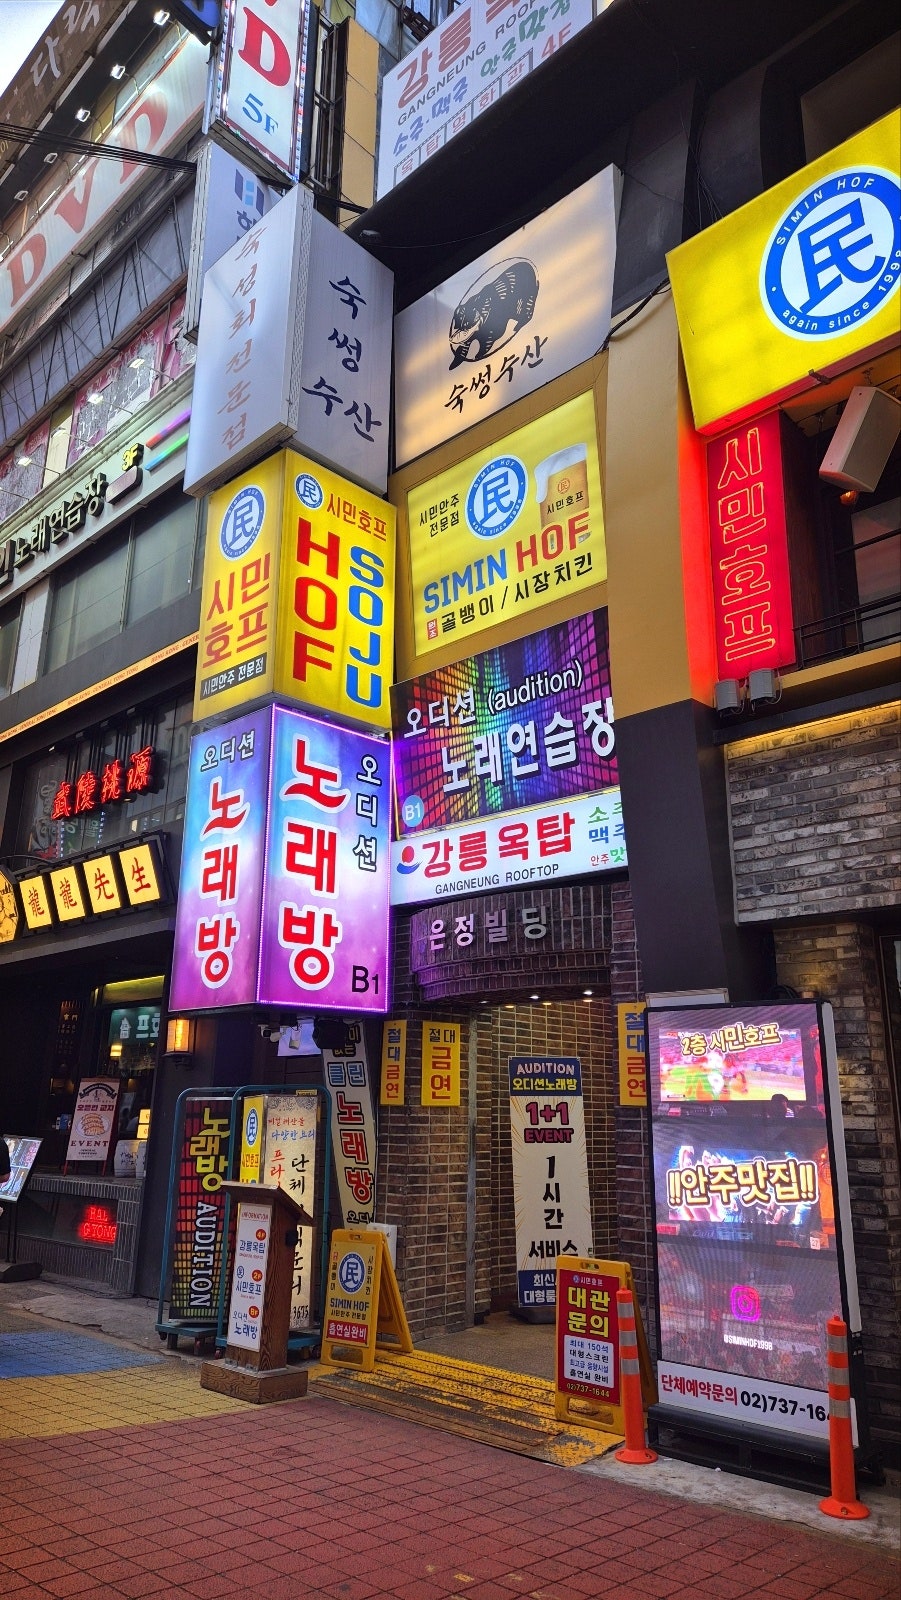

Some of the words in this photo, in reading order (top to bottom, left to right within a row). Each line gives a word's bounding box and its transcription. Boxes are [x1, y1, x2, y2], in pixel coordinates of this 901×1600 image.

[541, 22, 572, 58] 4F
[397, 40, 486, 127] GANGNEUNG
[5, 91, 168, 307] DVD
[776, 190, 823, 246] SIMIN
[836, 176, 875, 192] HOF
[797, 197, 886, 315] 民
[782, 308, 818, 331] again
[828, 300, 870, 329] since
[301, 275, 383, 443] 숙썽수산
[444, 335, 549, 412] 숙썽수산
[327, 493, 387, 542] 시민호프
[420, 493, 460, 527] 시민안주
[480, 470, 515, 528] 民
[546, 491, 584, 515] 시민호프
[231, 499, 254, 548] 民
[429, 510, 460, 538] 전문점
[717, 427, 776, 662] 시민호프
[206, 552, 271, 621] 시민
[423, 548, 508, 614] SIMIN
[515, 511, 590, 573] HOF
[292, 516, 340, 683] HOF
[441, 594, 494, 634] 골뱅이
[514, 552, 594, 603] 시장치킨
[202, 602, 268, 669] 호프
[346, 545, 385, 708] SOJU
[202, 669, 236, 698] 시민안주
[237, 656, 265, 683] 전문점
[403, 688, 475, 739] 오디션
[487, 659, 583, 715] (audition)
[201, 730, 255, 772] 오디션
[441, 697, 616, 793] 노래연습장
[352, 754, 382, 873] 오디션
[403, 804, 422, 823] B1
[198, 780, 250, 984] 노래방
[284, 738, 348, 985] 노래방
[435, 874, 500, 895] GANGNEUNG
[505, 863, 560, 883] ROOFTOP
[27, 856, 151, 919] 龍龍先生
[429, 905, 547, 951] 은정빌딩
[351, 965, 379, 994] B1
[386, 1028, 400, 1061] 절대
[429, 1027, 456, 1043] 절대
[682, 1034, 708, 1056] 2층
[710, 1023, 783, 1053] 시민호프
[386, 1064, 400, 1099] 금연
[430, 1046, 451, 1100] 금연
[512, 1077, 578, 1092] 오디션노래방
[516, 1062, 575, 1076] AUDITION
[524, 1128, 574, 1143] EVENT
[525, 1101, 569, 1126] 1+1
[189, 1107, 231, 1192] 노래방
[336, 1092, 373, 1204] 노래방
[189, 1201, 218, 1307] AUDITION
[344, 1261, 359, 1285] 民
[528, 1239, 579, 1260] 서비스
[235, 1280, 262, 1296] 시민호프
[329, 1298, 352, 1310] SIMIN
[352, 1300, 370, 1312] HOF
[567, 1286, 611, 1313] 대관
[234, 1321, 258, 1340] 노래방
[567, 1311, 610, 1338] 문의
[661, 1374, 738, 1406] 단체예약문의
[740, 1390, 831, 1422] 02)737-16
